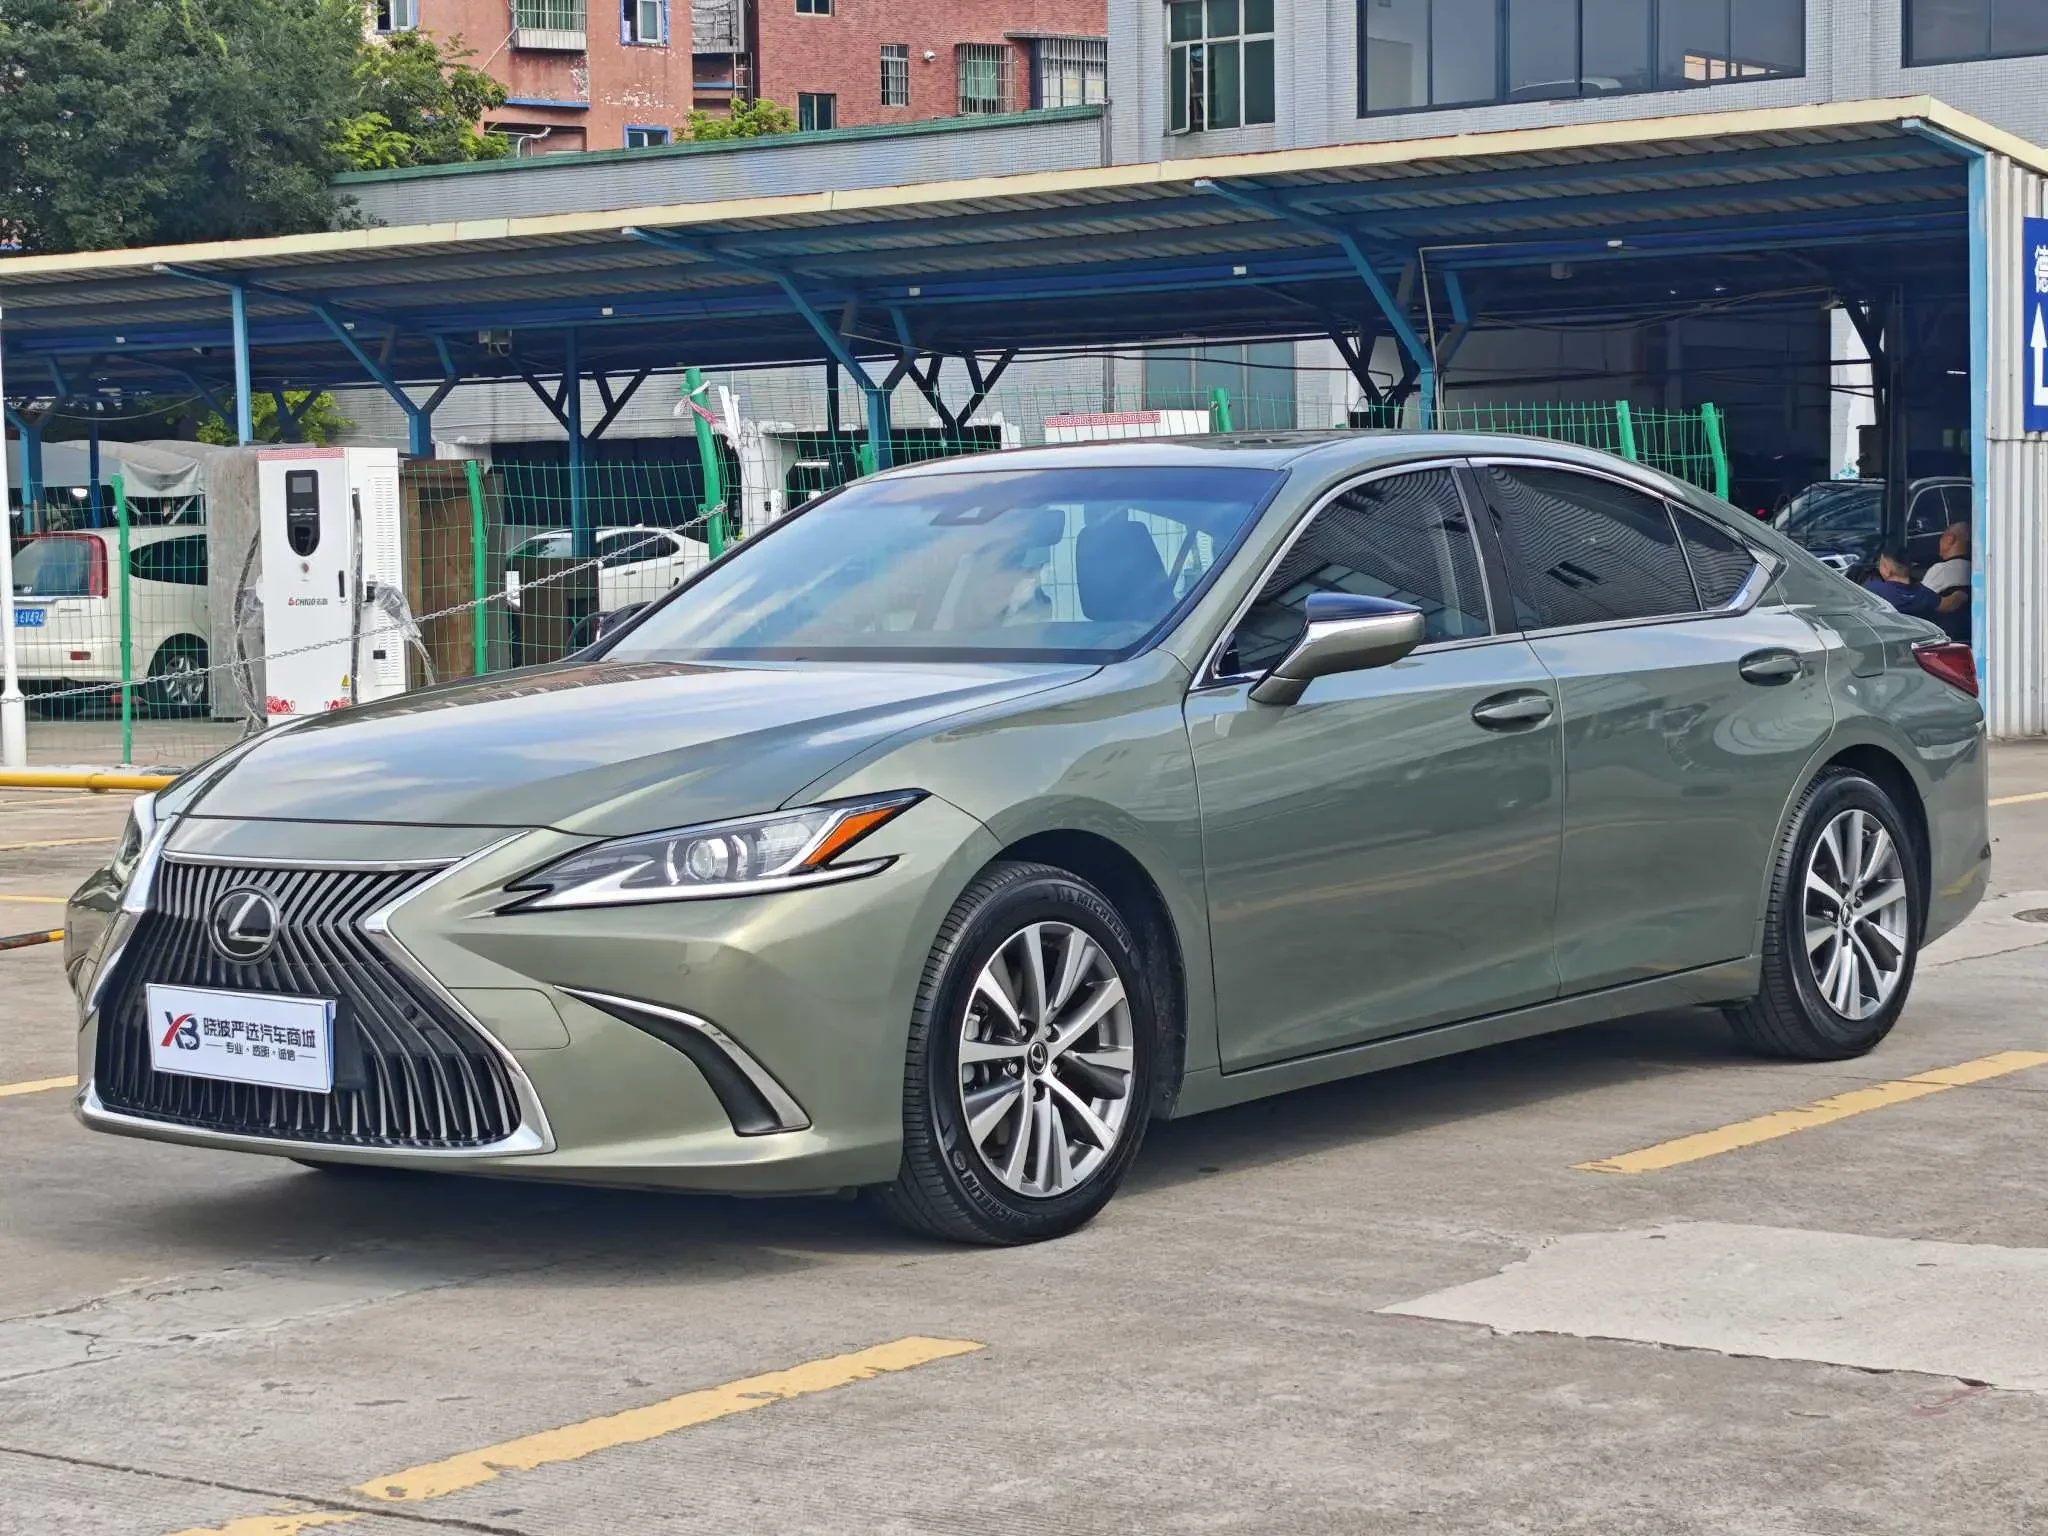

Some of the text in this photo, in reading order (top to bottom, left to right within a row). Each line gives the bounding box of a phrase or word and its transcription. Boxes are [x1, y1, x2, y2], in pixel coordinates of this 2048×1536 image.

[203, 1017, 316, 1049] 晓波严选汽车商城
